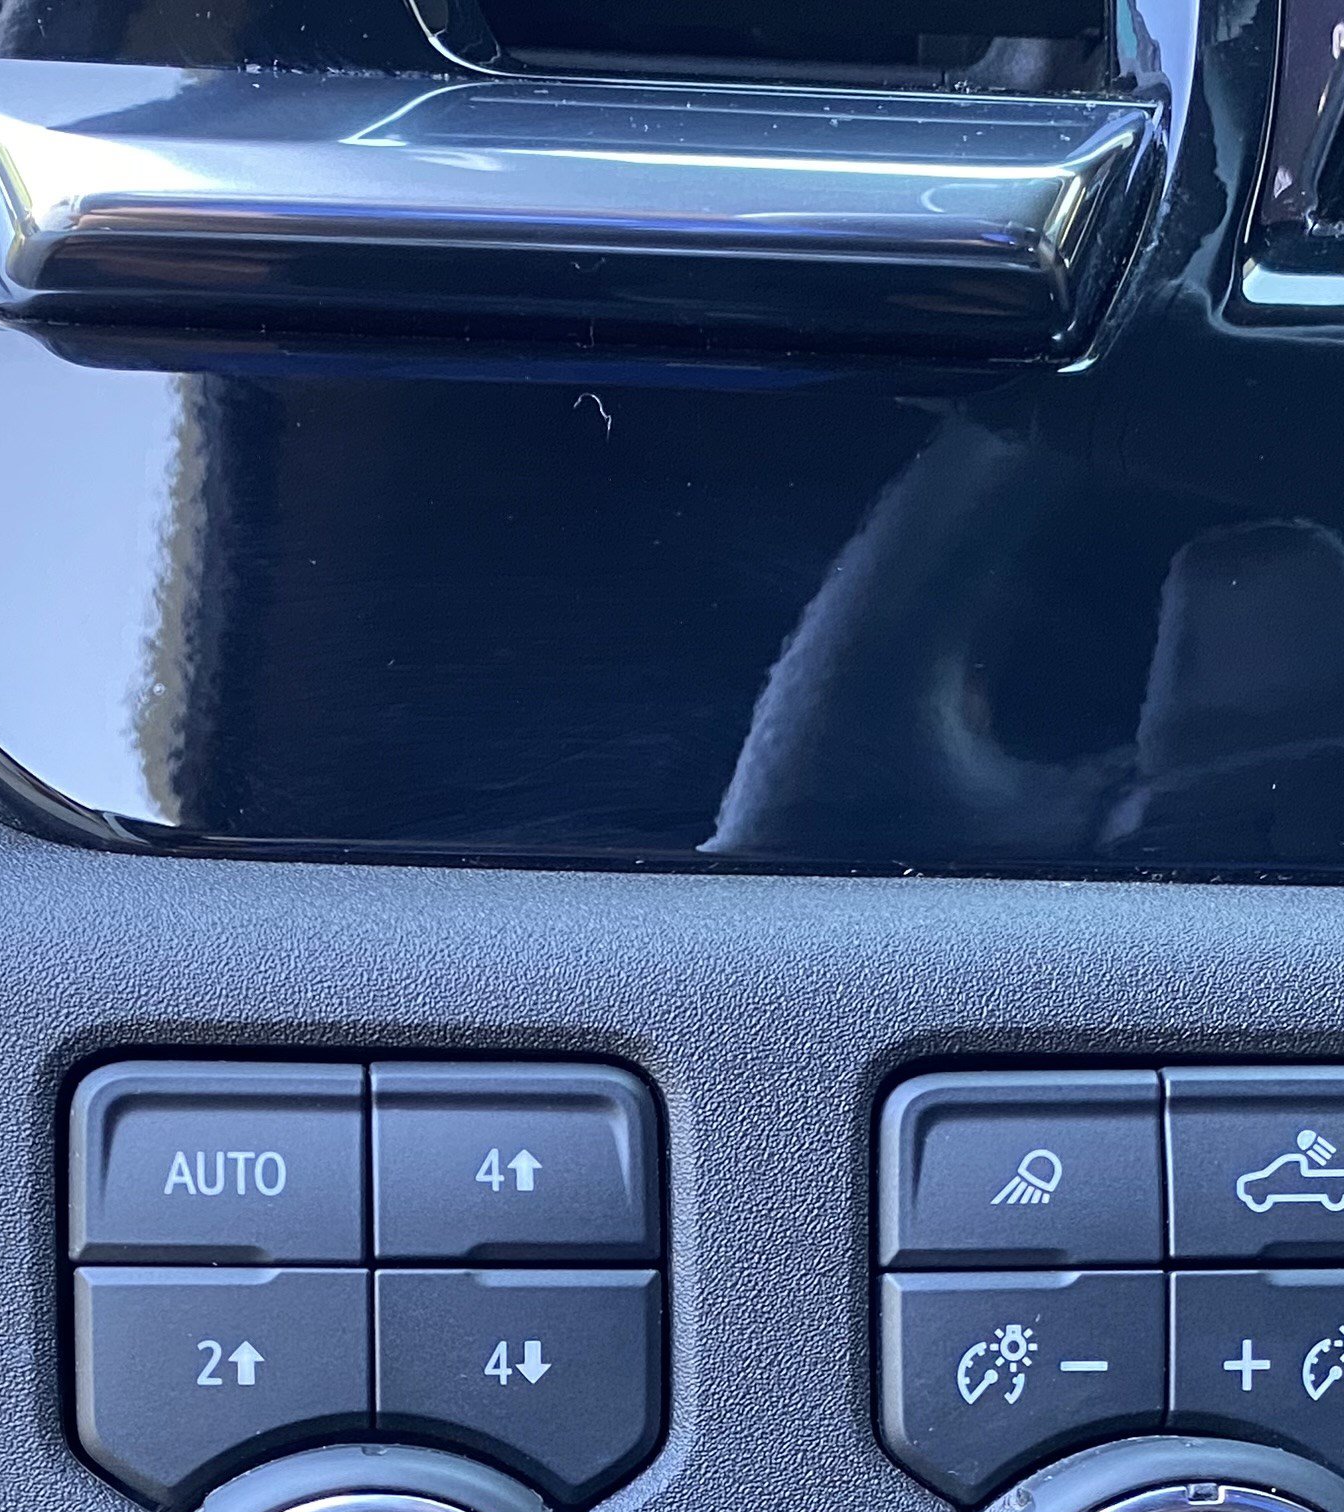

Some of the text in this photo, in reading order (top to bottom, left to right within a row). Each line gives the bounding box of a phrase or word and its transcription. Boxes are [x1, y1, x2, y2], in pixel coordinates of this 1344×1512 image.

[164, 1151, 287, 1196] AUTO
[475, 1148, 505, 1192] 4
[196, 1340, 223, 1386] 2
[484, 1340, 513, 1386] 4
